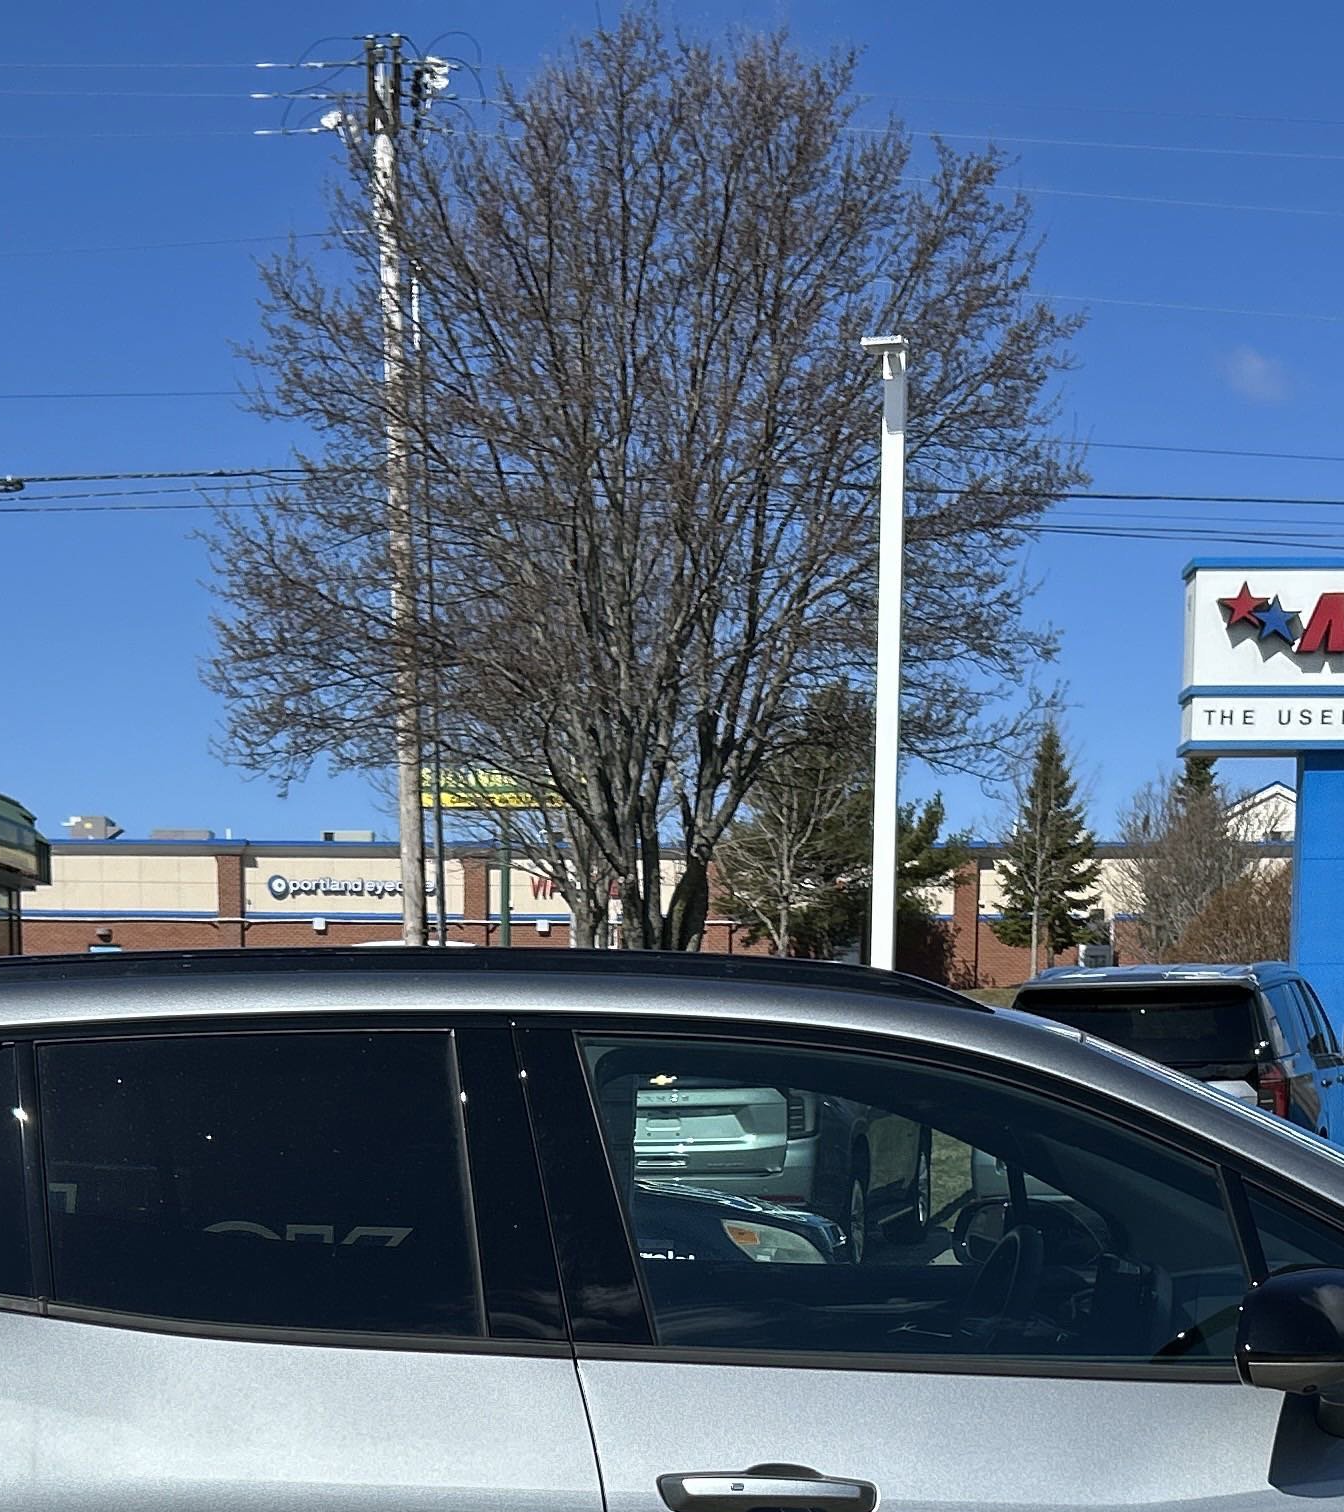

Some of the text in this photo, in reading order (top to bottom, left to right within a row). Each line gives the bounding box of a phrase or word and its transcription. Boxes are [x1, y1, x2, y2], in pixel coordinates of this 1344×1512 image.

[1204, 709, 1254, 726] THE
[288, 877, 437, 896] portland eyece
